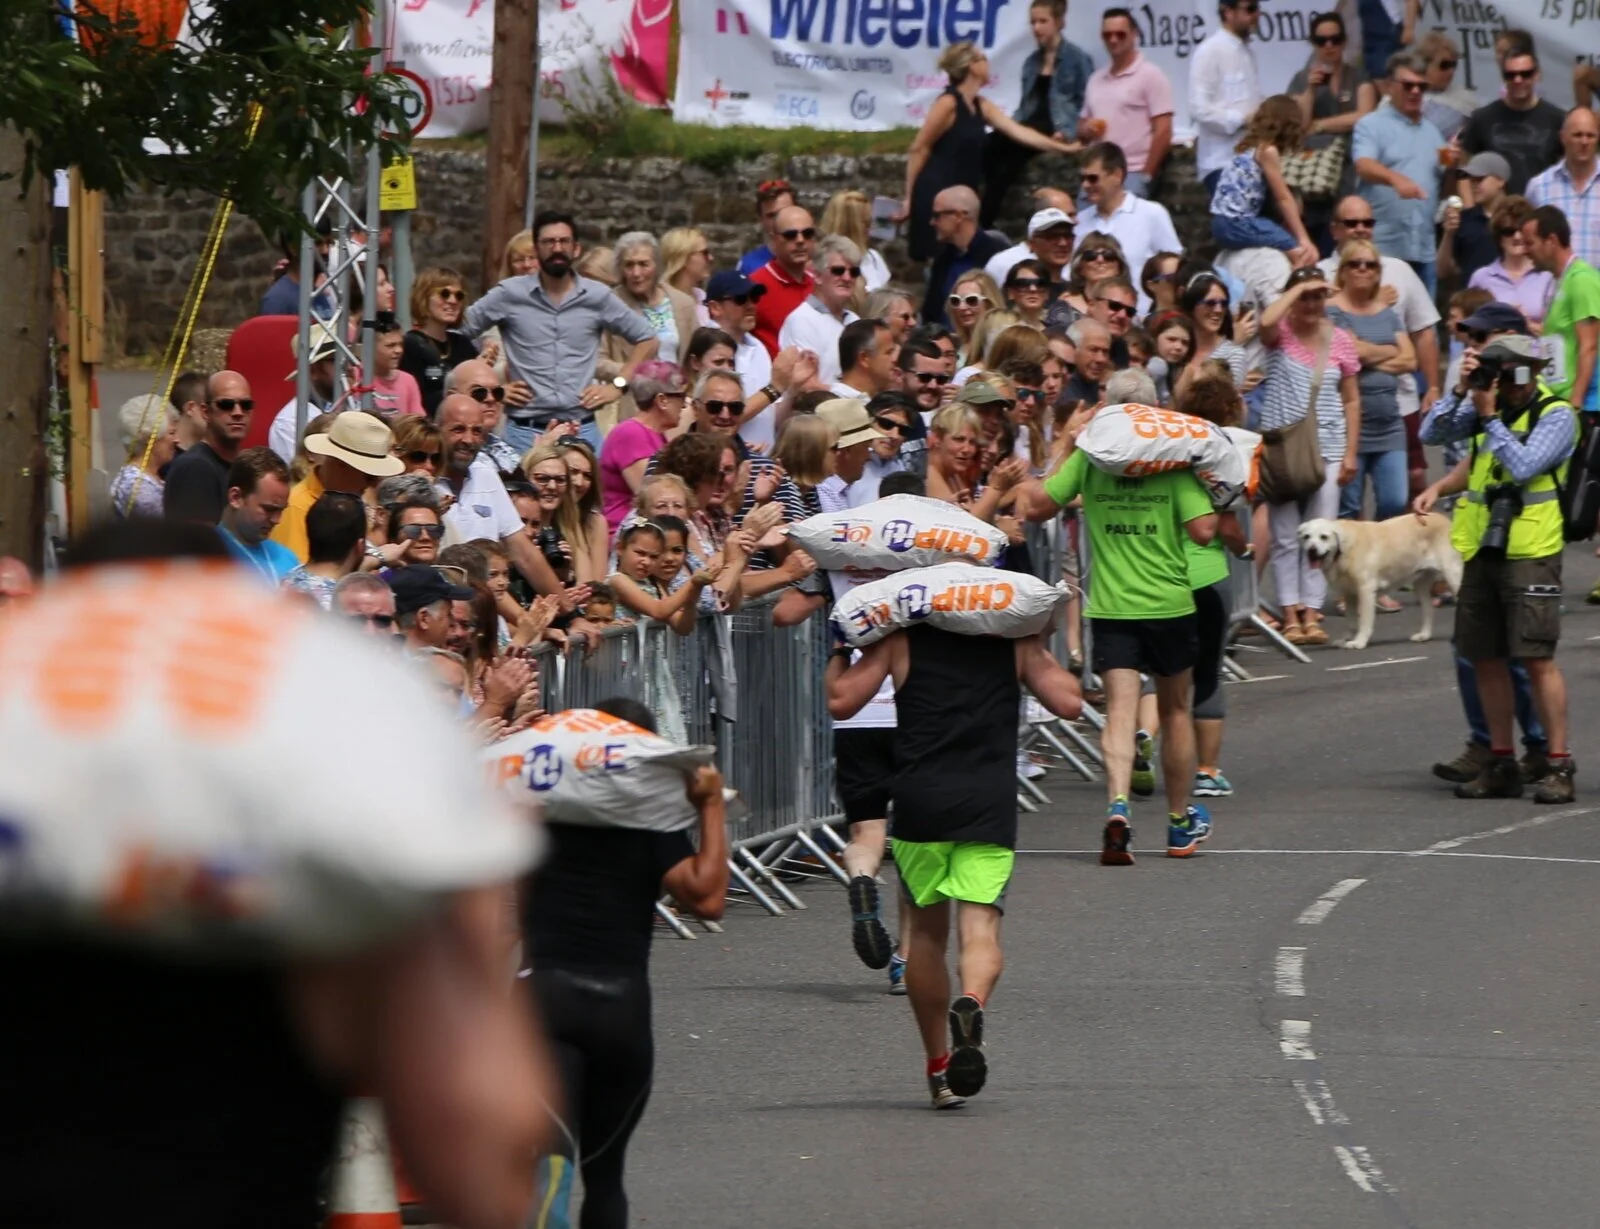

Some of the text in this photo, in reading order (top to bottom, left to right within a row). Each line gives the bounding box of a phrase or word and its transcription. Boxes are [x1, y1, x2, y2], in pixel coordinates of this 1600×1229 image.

[773, 50, 894, 74] ELECTRICAL LIMITED
[1105, 524, 1157, 535] PAUL M
[914, 527, 991, 561] CHIP
[931, 582, 1014, 612] CHIP
